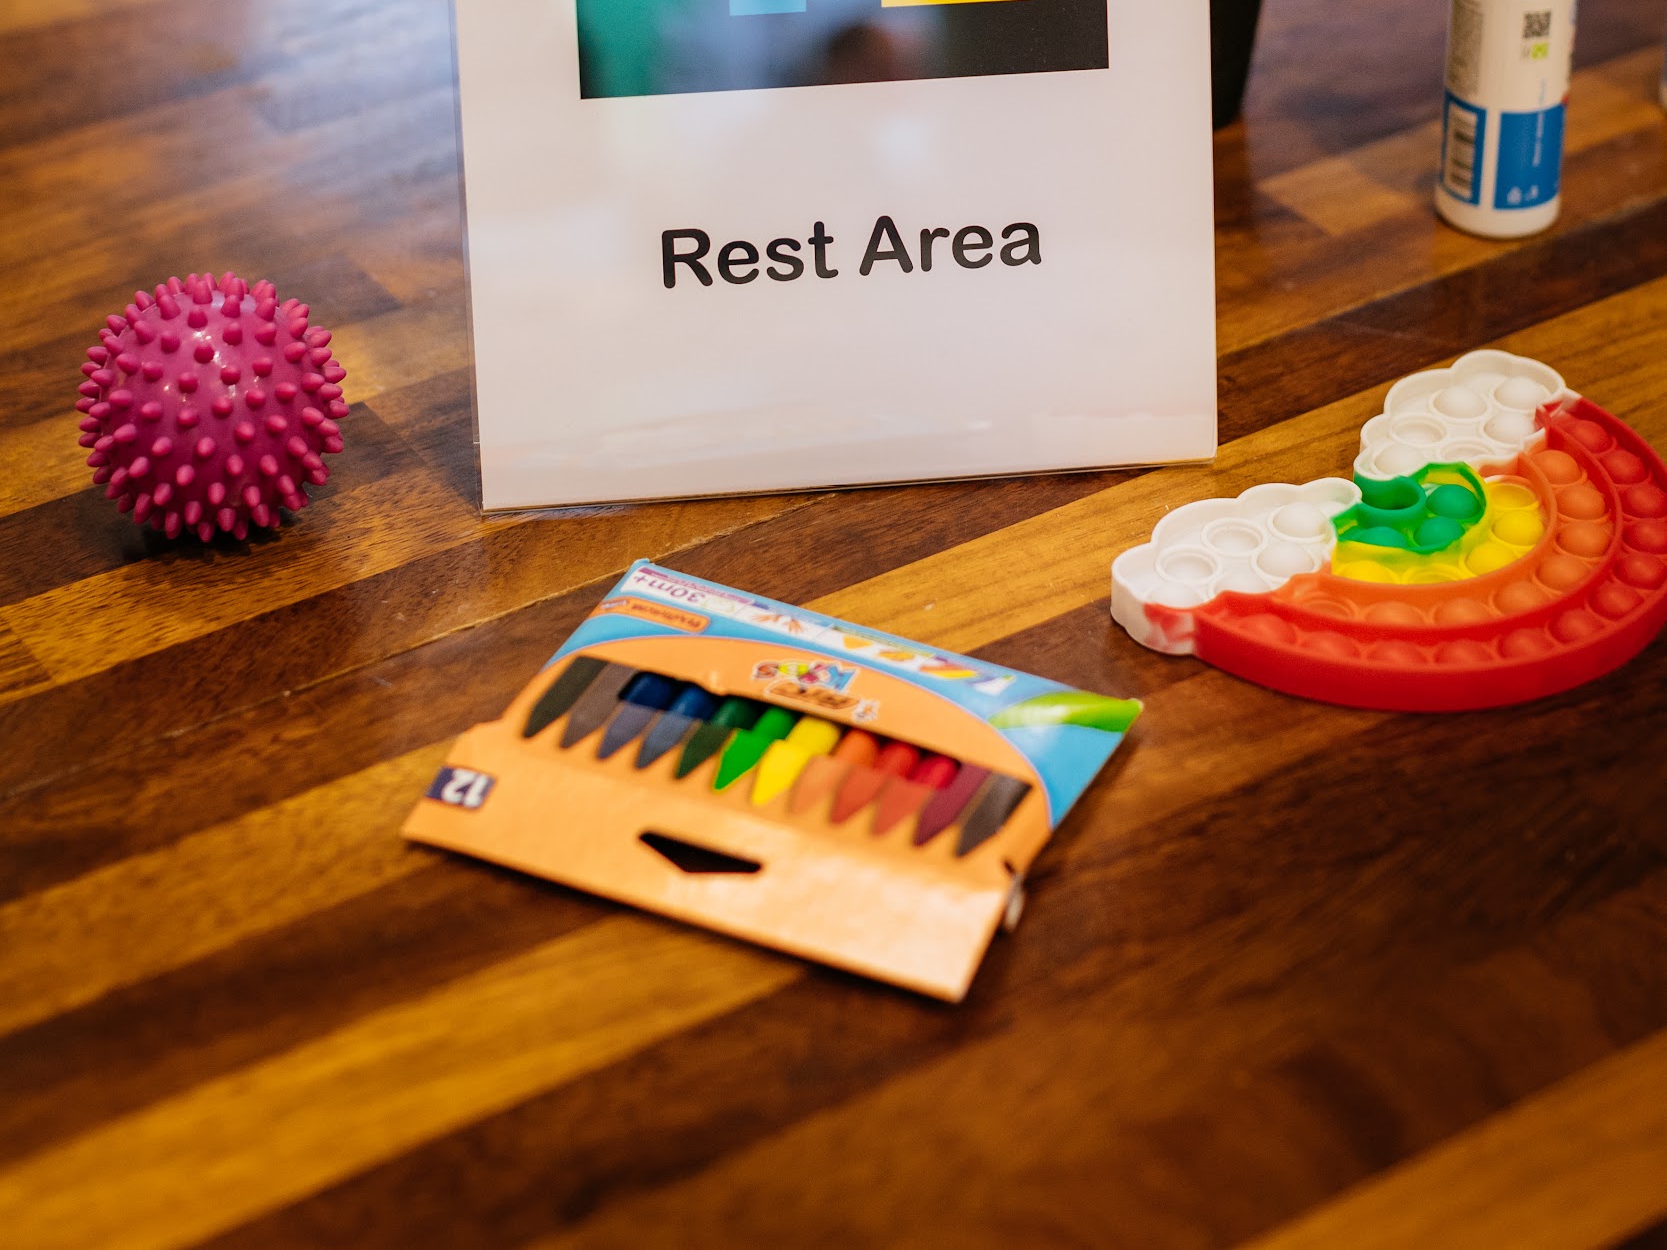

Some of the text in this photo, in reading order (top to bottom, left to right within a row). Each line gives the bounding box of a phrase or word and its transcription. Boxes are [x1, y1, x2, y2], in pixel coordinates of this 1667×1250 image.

[661, 215, 1042, 290] Rest Area
[441, 768, 488, 807] 12
